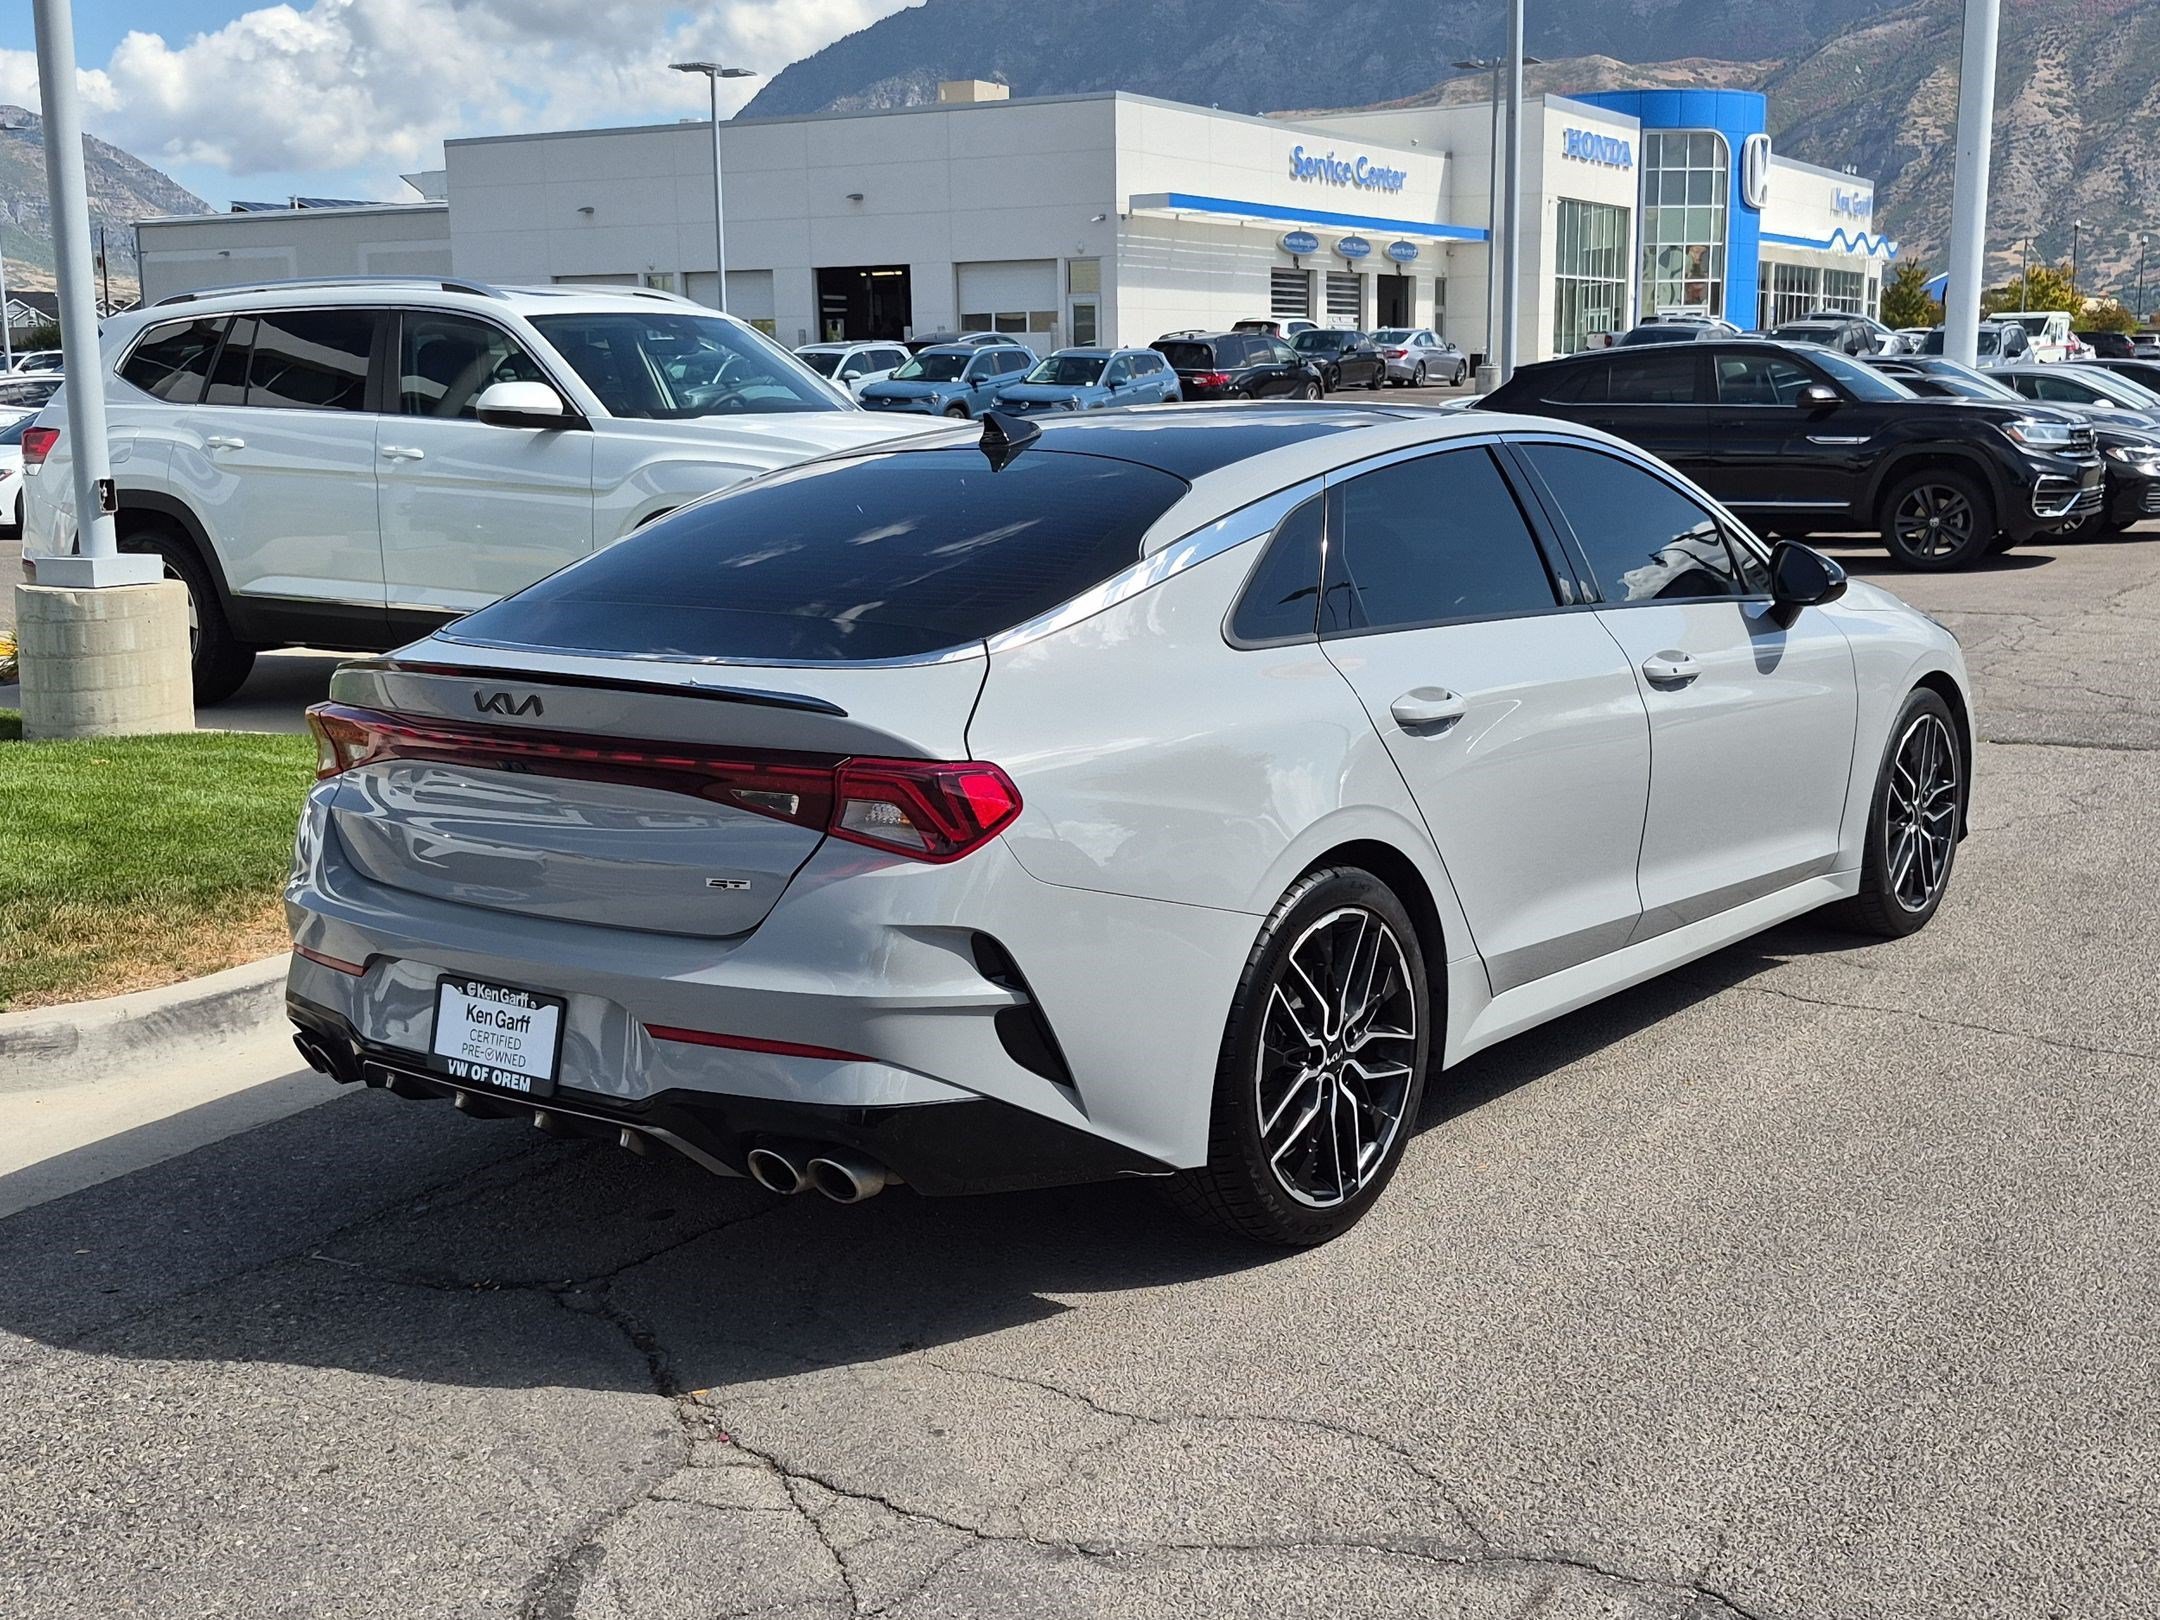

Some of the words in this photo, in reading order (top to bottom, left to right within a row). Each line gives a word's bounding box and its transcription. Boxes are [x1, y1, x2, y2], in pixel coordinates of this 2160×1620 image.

[1564, 128, 1633, 167] HONDA
[1290, 146, 1351, 182] Service
[1355, 156, 1407, 191] Center
[477, 983, 499, 1001] Ken
[500, 988, 529, 1008] Garff
[466, 1003, 493, 1026] Ken
[495, 1010, 531, 1033] Garff
[469, 1028, 522, 1051] CERTIFIED
[448, 1059, 468, 1077] VW
[471, 1065, 490, 1082] OF
[492, 1070, 531, 1093] OREM
